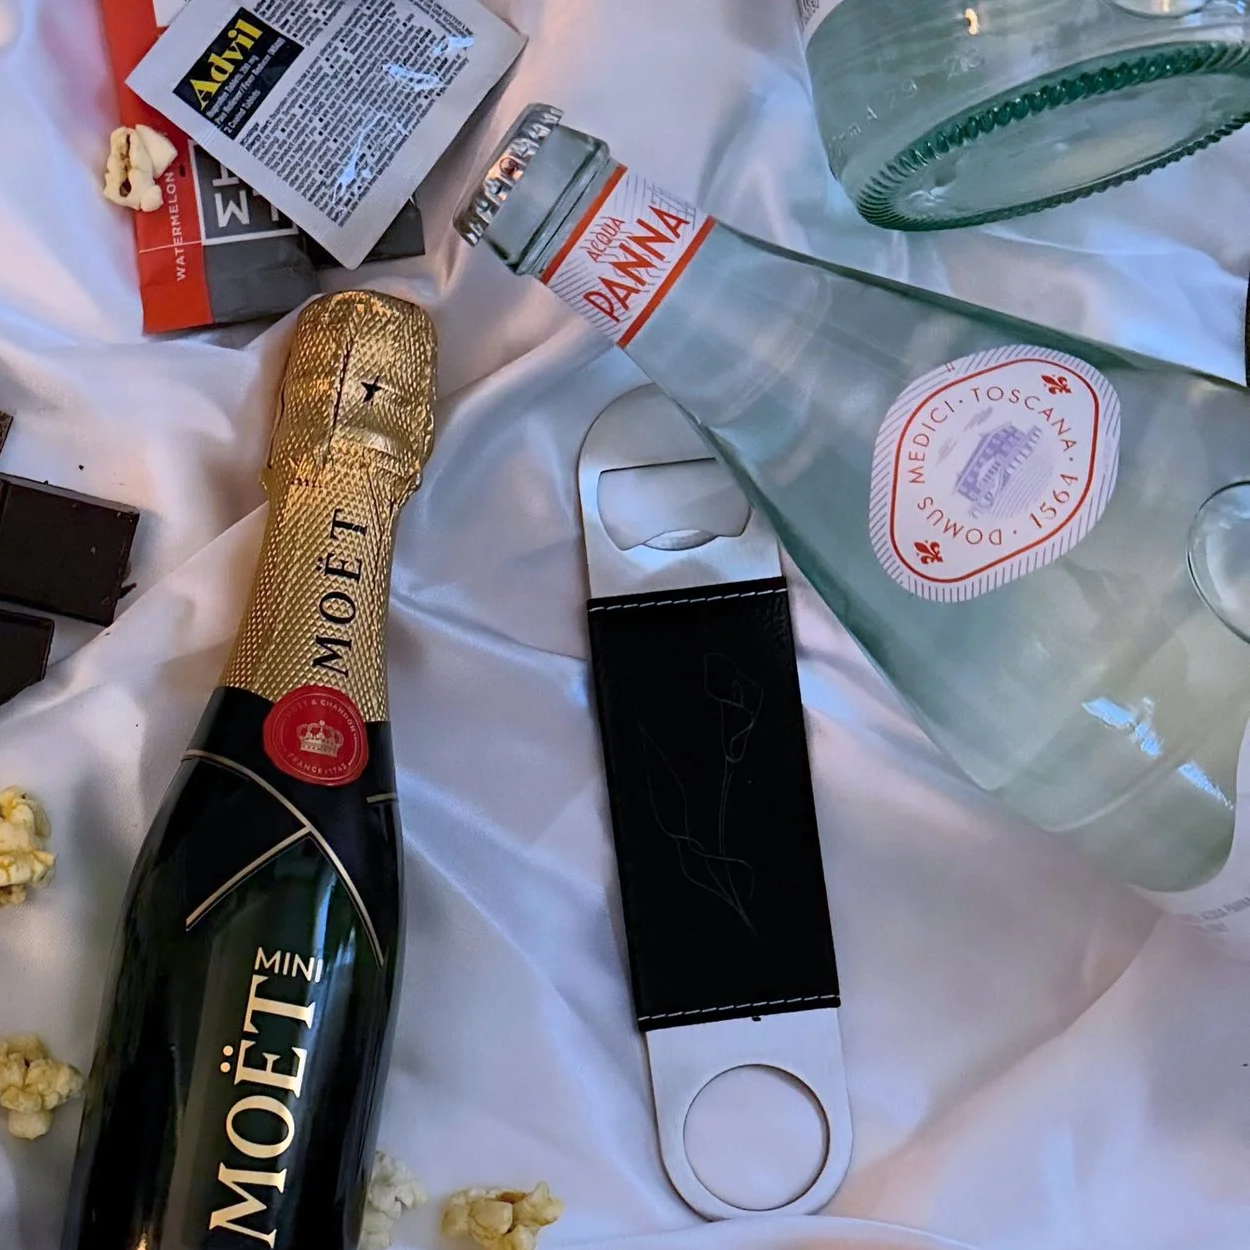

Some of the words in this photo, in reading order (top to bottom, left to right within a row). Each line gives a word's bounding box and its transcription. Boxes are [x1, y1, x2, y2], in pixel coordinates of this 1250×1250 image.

[189, 18, 264, 110] Advil
[165, 171, 186, 282] WATERMELON
[583, 205, 690, 323] PANNA
[587, 217, 625, 263] ACQUA
[908, 400, 955, 485] MEDICI
[970, 386, 1078, 452] TOSCANA
[917, 497, 1002, 546] DOMUS
[1029, 472, 1079, 529] 1564
[312, 508, 368, 677] MOËT
[254, 946, 323, 983] MINI
[209, 974, 316, 1249] MOËT
